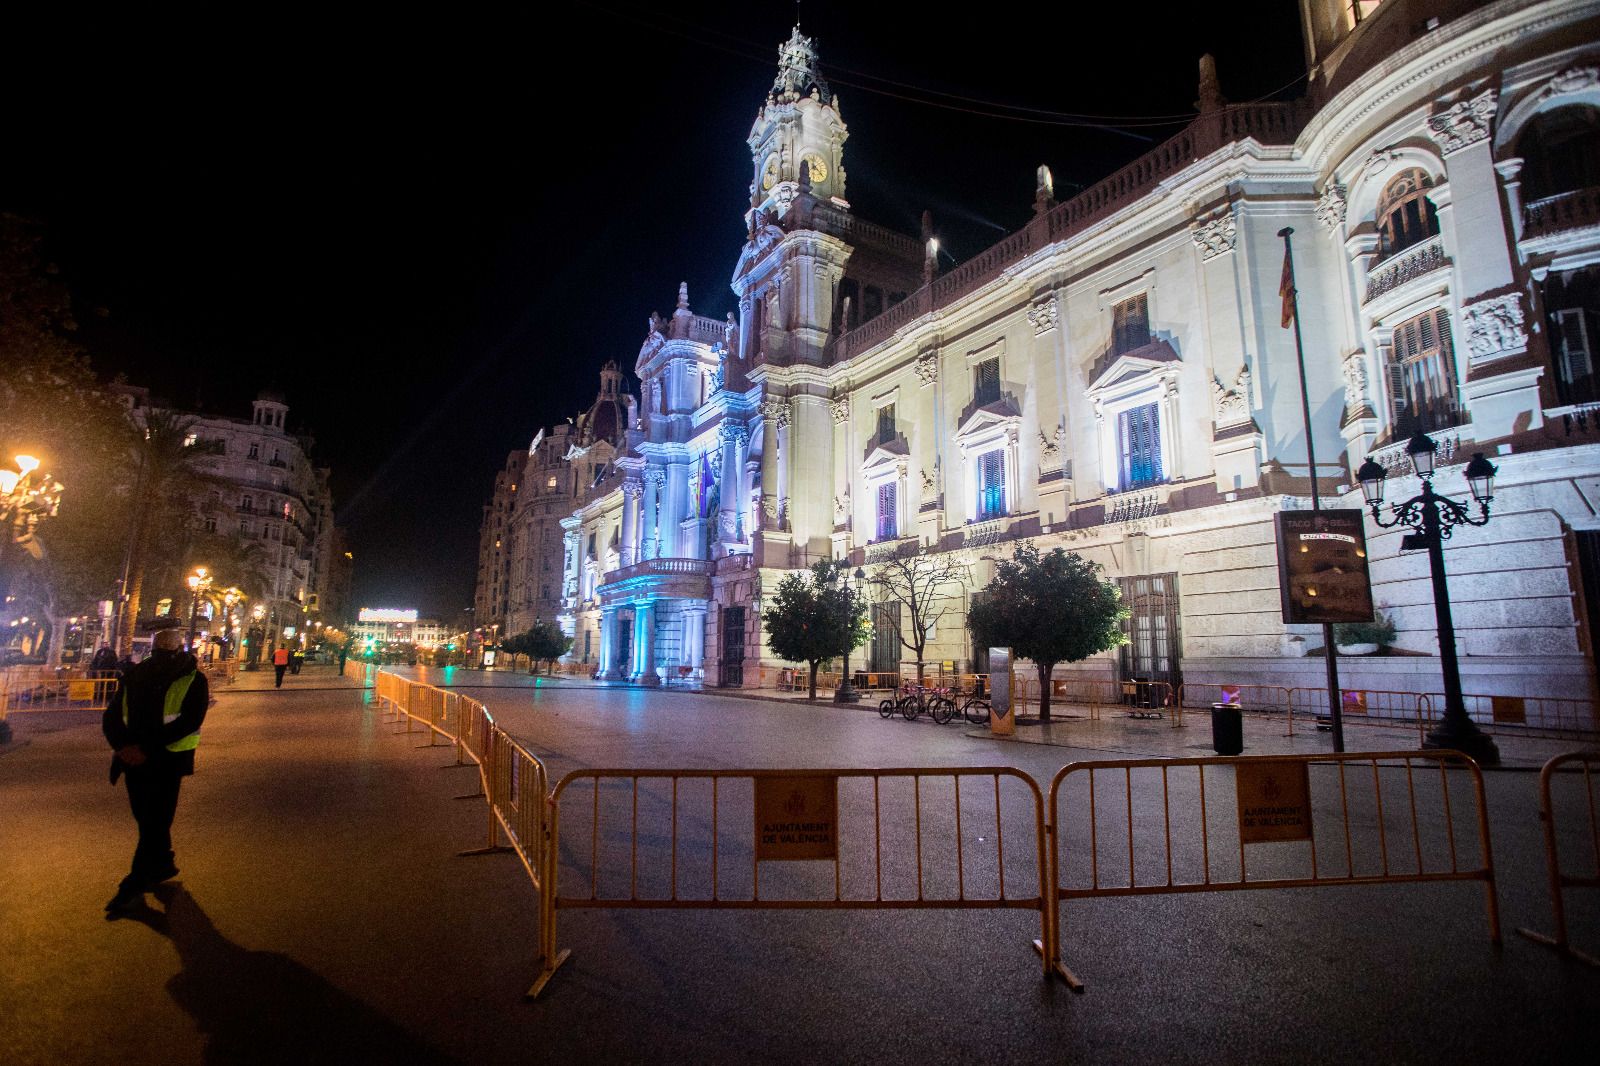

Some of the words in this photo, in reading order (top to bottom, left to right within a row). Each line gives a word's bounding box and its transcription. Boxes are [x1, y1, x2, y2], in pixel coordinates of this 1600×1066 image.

[1244, 807, 1301, 816] AJUNTAMENT
[1244, 817, 1256, 826] DE
[763, 823, 829, 832] AJUNTAMENT
[762, 835, 777, 844] DE
